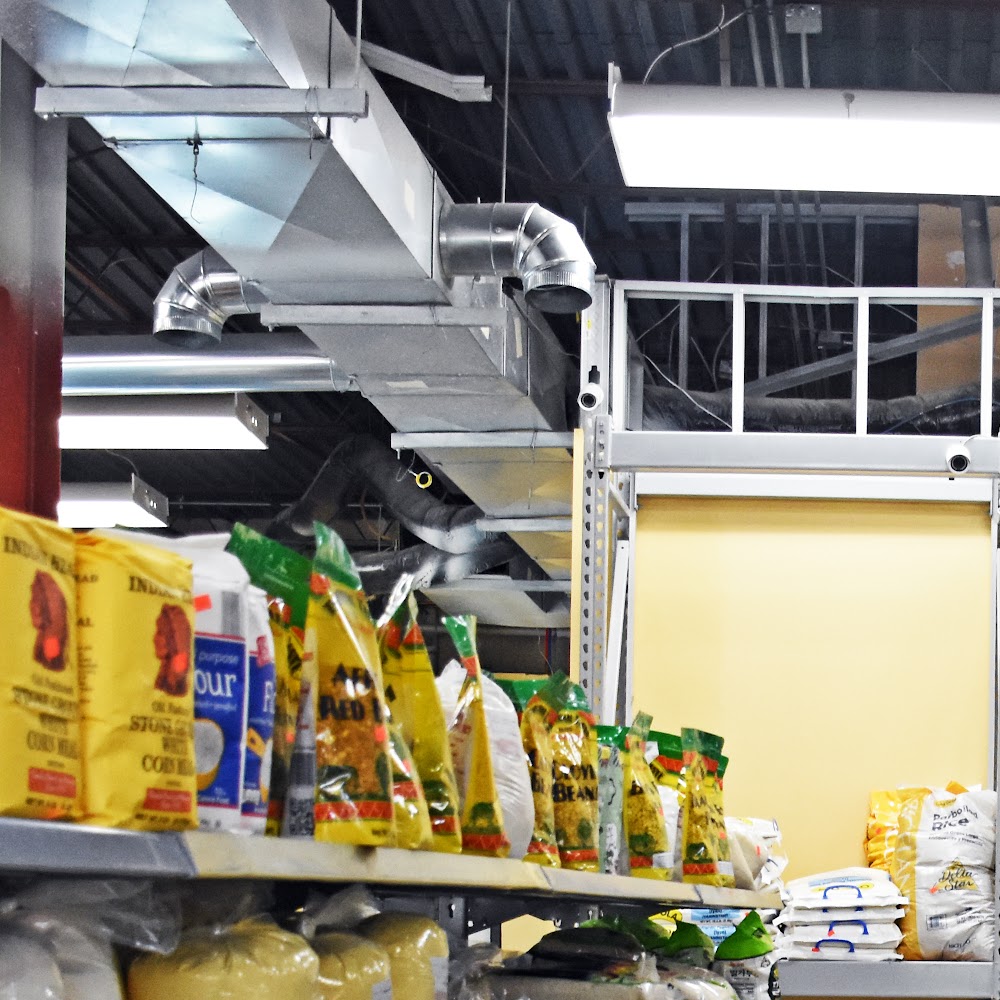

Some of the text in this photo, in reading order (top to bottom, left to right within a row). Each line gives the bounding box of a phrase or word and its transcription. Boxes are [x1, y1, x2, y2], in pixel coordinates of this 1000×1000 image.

[200, 652, 239, 666] purpose
[195, 669, 238, 698] our
[932, 817, 970, 832] Rice
[939, 869, 974, 884] Delta
[944, 878, 974, 891] Star
